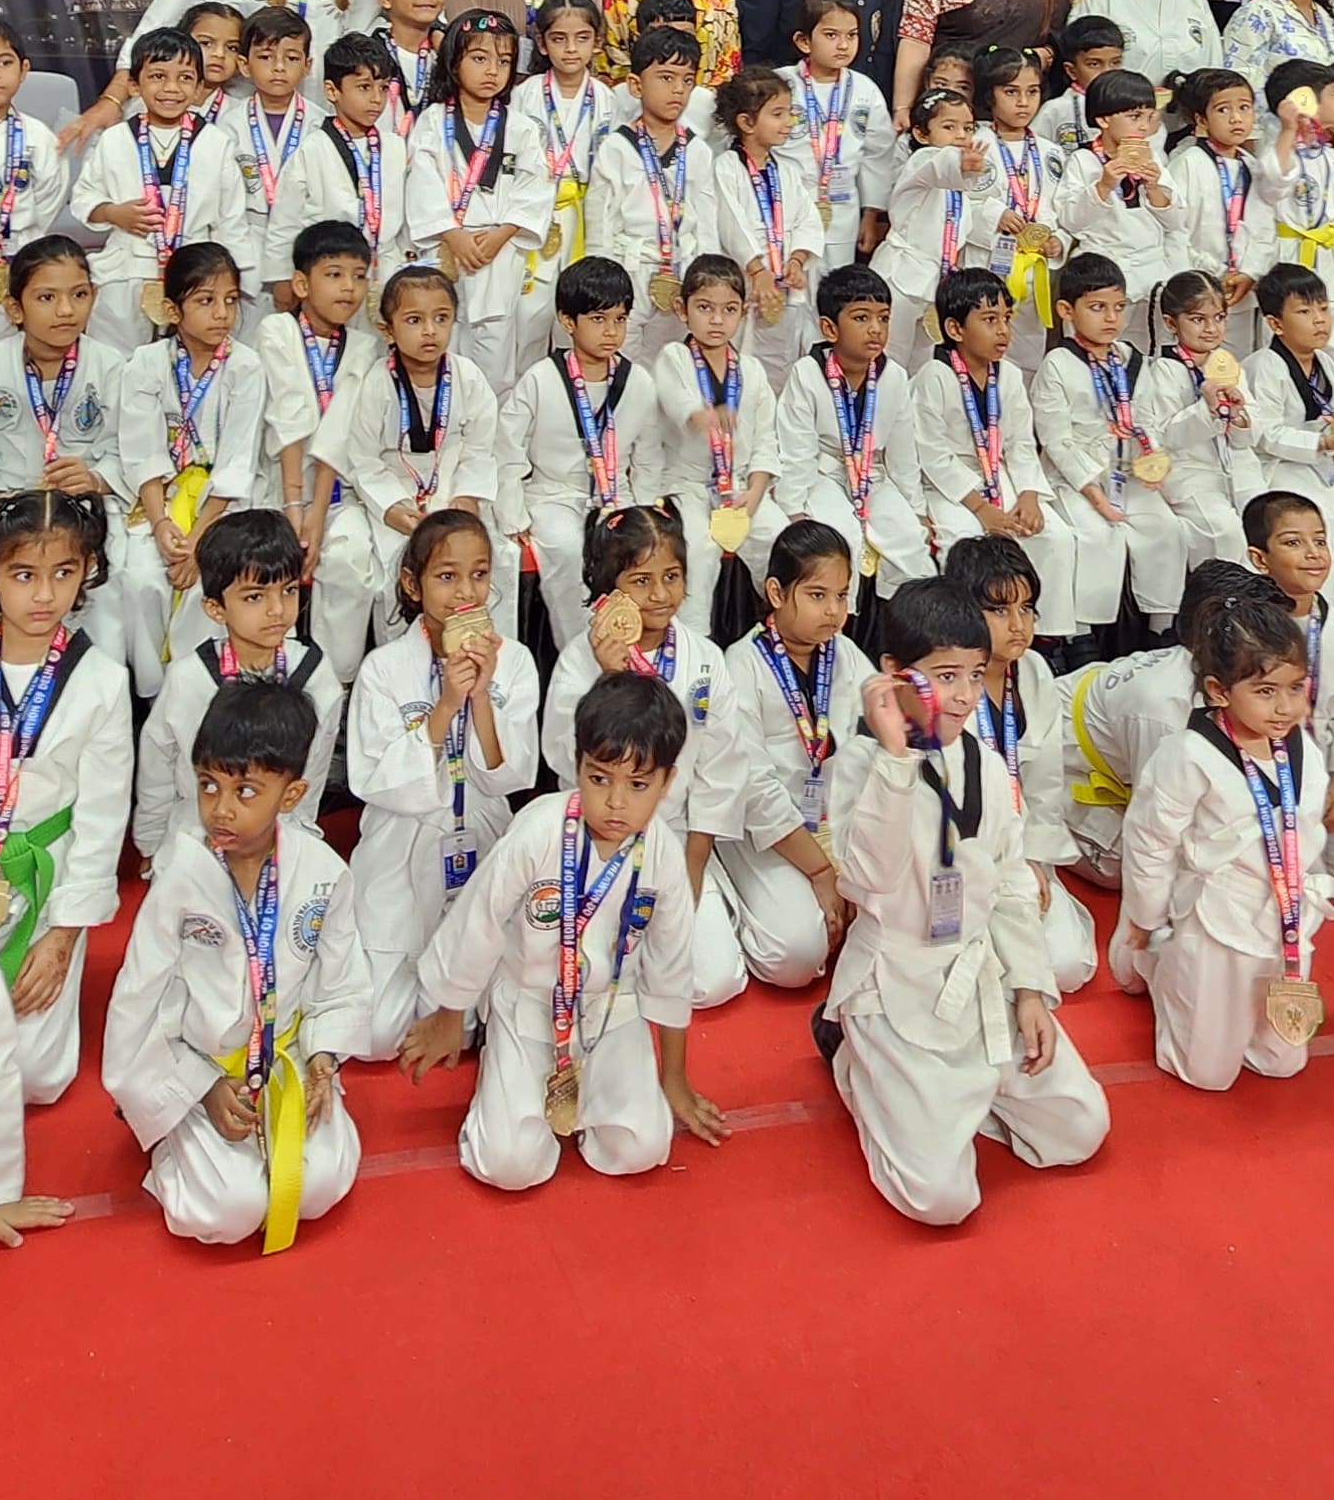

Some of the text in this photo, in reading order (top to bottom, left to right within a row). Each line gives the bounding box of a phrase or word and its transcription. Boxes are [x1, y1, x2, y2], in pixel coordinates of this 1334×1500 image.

[563, 837, 576, 868] DELHI
[563, 869, 576, 883] OF
[265, 885, 277, 914] DELHI
[260, 917, 274, 931] OF
